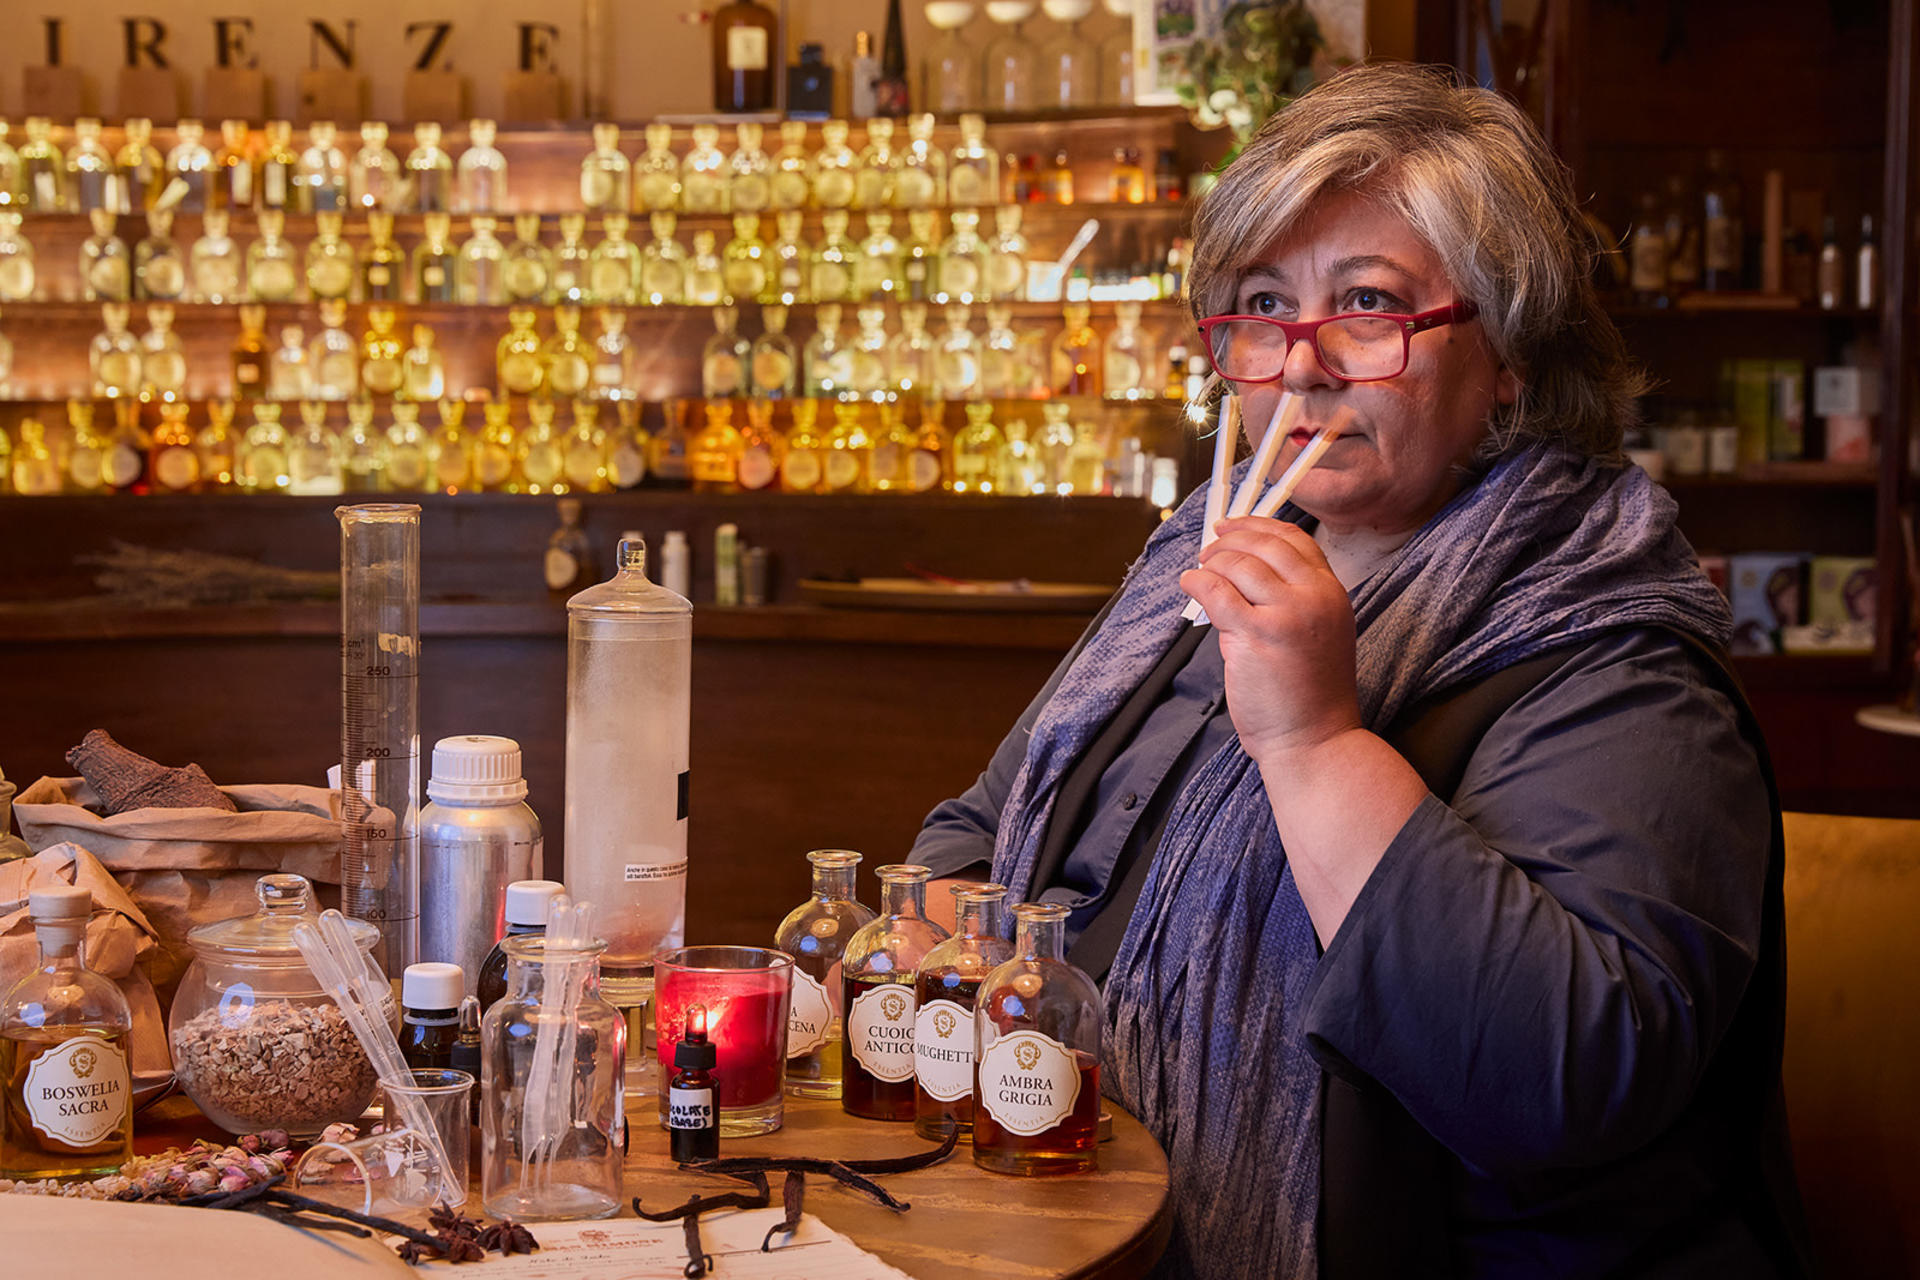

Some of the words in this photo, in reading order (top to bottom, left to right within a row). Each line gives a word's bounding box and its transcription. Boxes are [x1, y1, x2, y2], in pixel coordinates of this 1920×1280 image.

[43, 17, 560, 72] IRENZE
[366, 666, 391, 676] 250
[366, 747, 391, 758] 200
[366, 829, 387, 839] 150
[366, 911, 386, 920] 100
[999, 1074, 1054, 1091] AMBRA
[998, 1089, 1053, 1107] GRIGIA
[58, 1099, 109, 1116] SACRA
